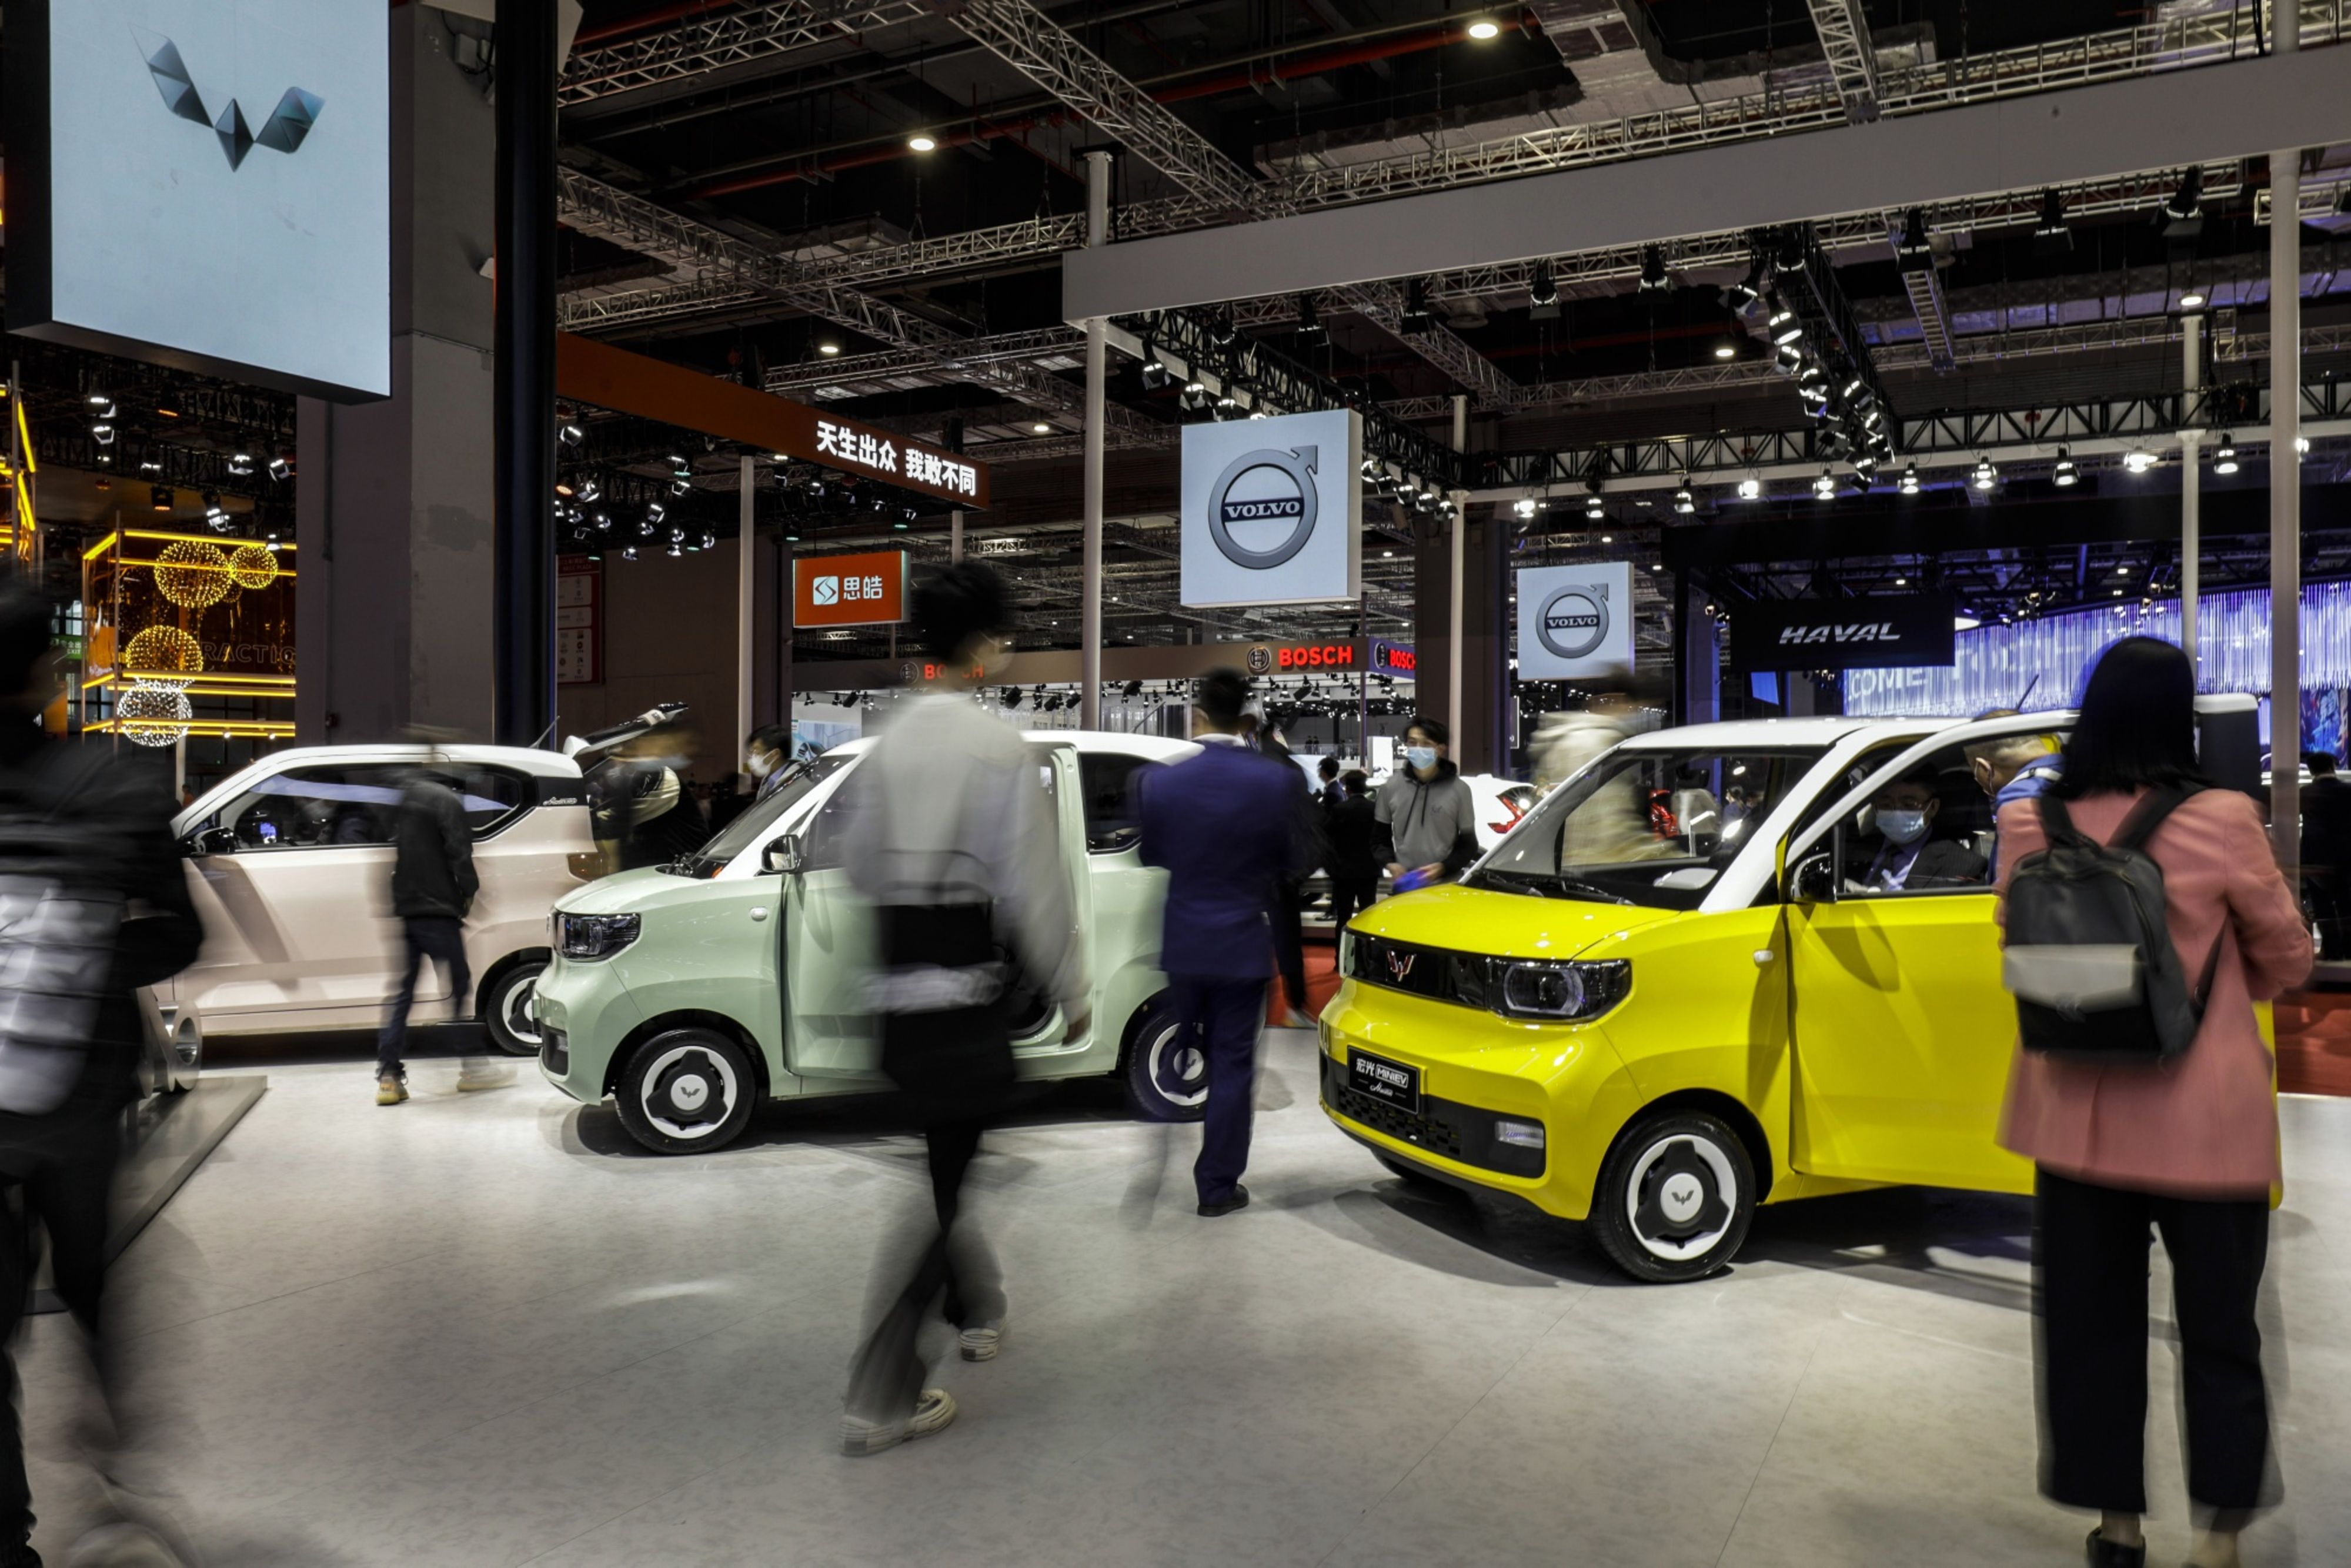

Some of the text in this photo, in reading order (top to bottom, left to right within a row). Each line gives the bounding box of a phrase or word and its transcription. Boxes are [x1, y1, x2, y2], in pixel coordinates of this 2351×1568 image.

[817, 420, 976, 496] 天生出众 我敢不同
[1224, 501, 1300, 518] VOLVO
[843, 576, 883, 600] 思皓
[1548, 616, 1598, 627] VOLVO
[1779, 623, 1901, 644] HAVAL
[1278, 646, 1352, 666] BOSCH
[1356, 1058, 1375, 1076] 宏光
